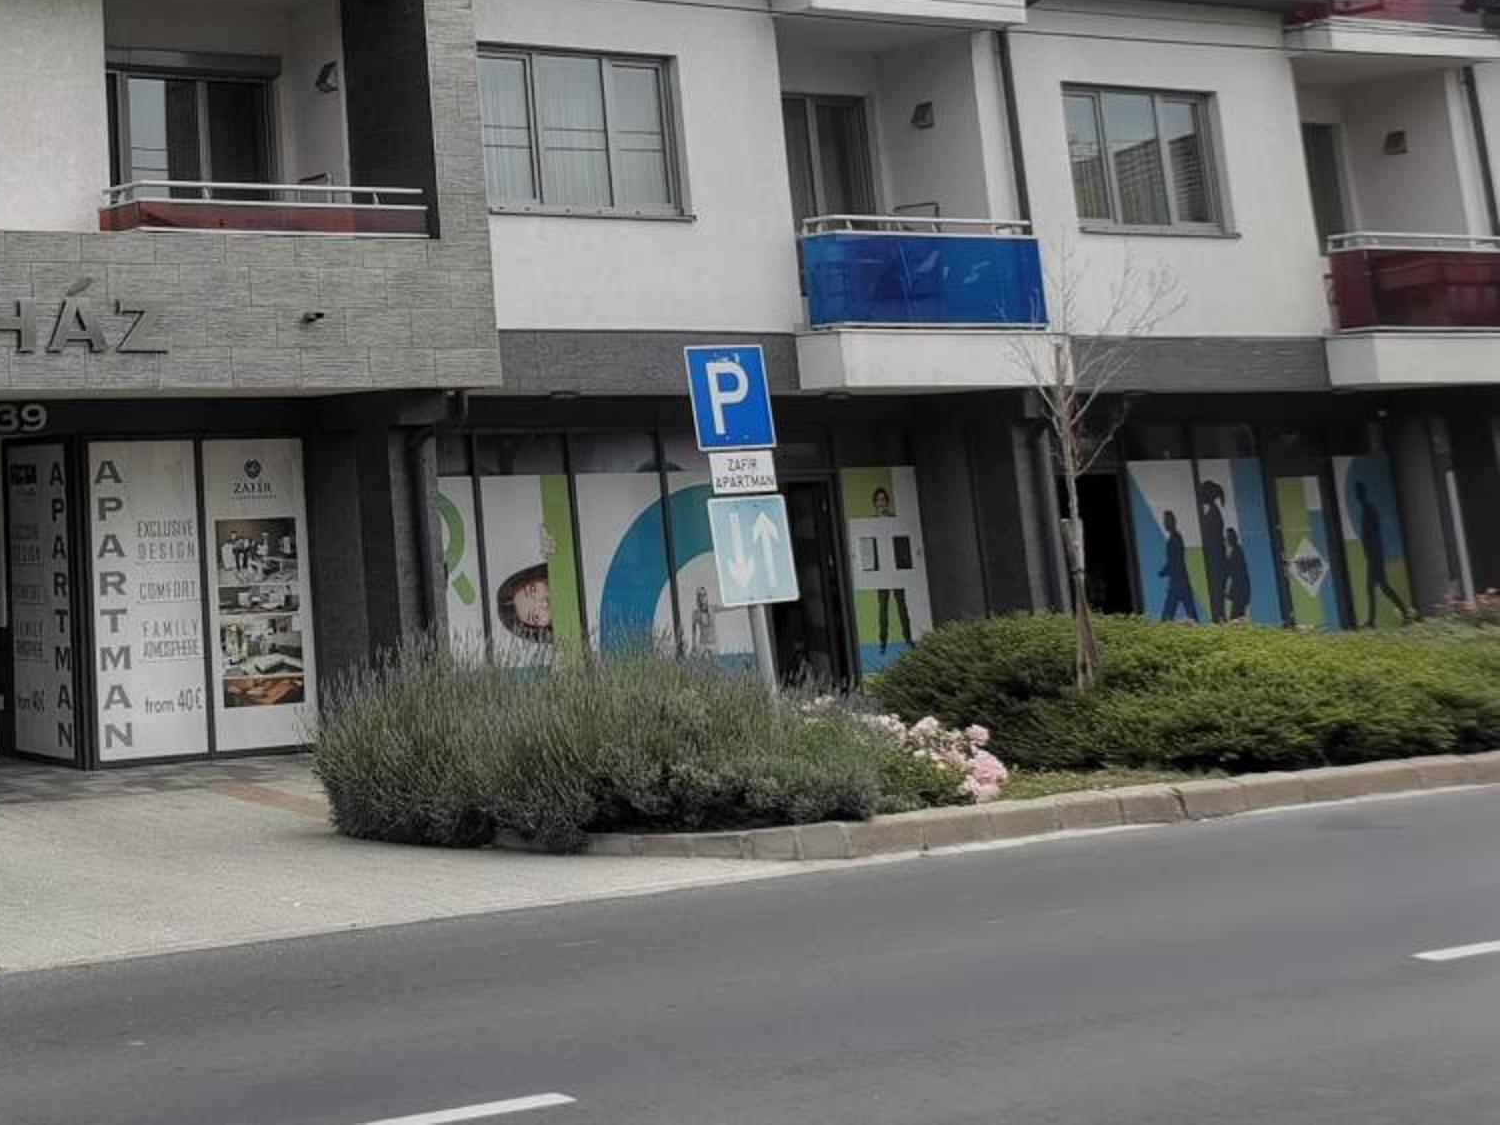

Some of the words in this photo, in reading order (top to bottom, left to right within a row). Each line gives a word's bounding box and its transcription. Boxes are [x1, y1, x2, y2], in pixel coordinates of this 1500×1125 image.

[706, 361, 749, 435] P
[715, 475, 775, 488] APARTMAN
[137, 541, 195, 560] DESIGN
[139, 580, 197, 600] COMFORT
[50, 461, 73, 747] APARTMAN
[94, 460, 133, 749] APARTMAN
[143, 618, 199, 636] FAMILY
[145, 696, 175, 715] from
